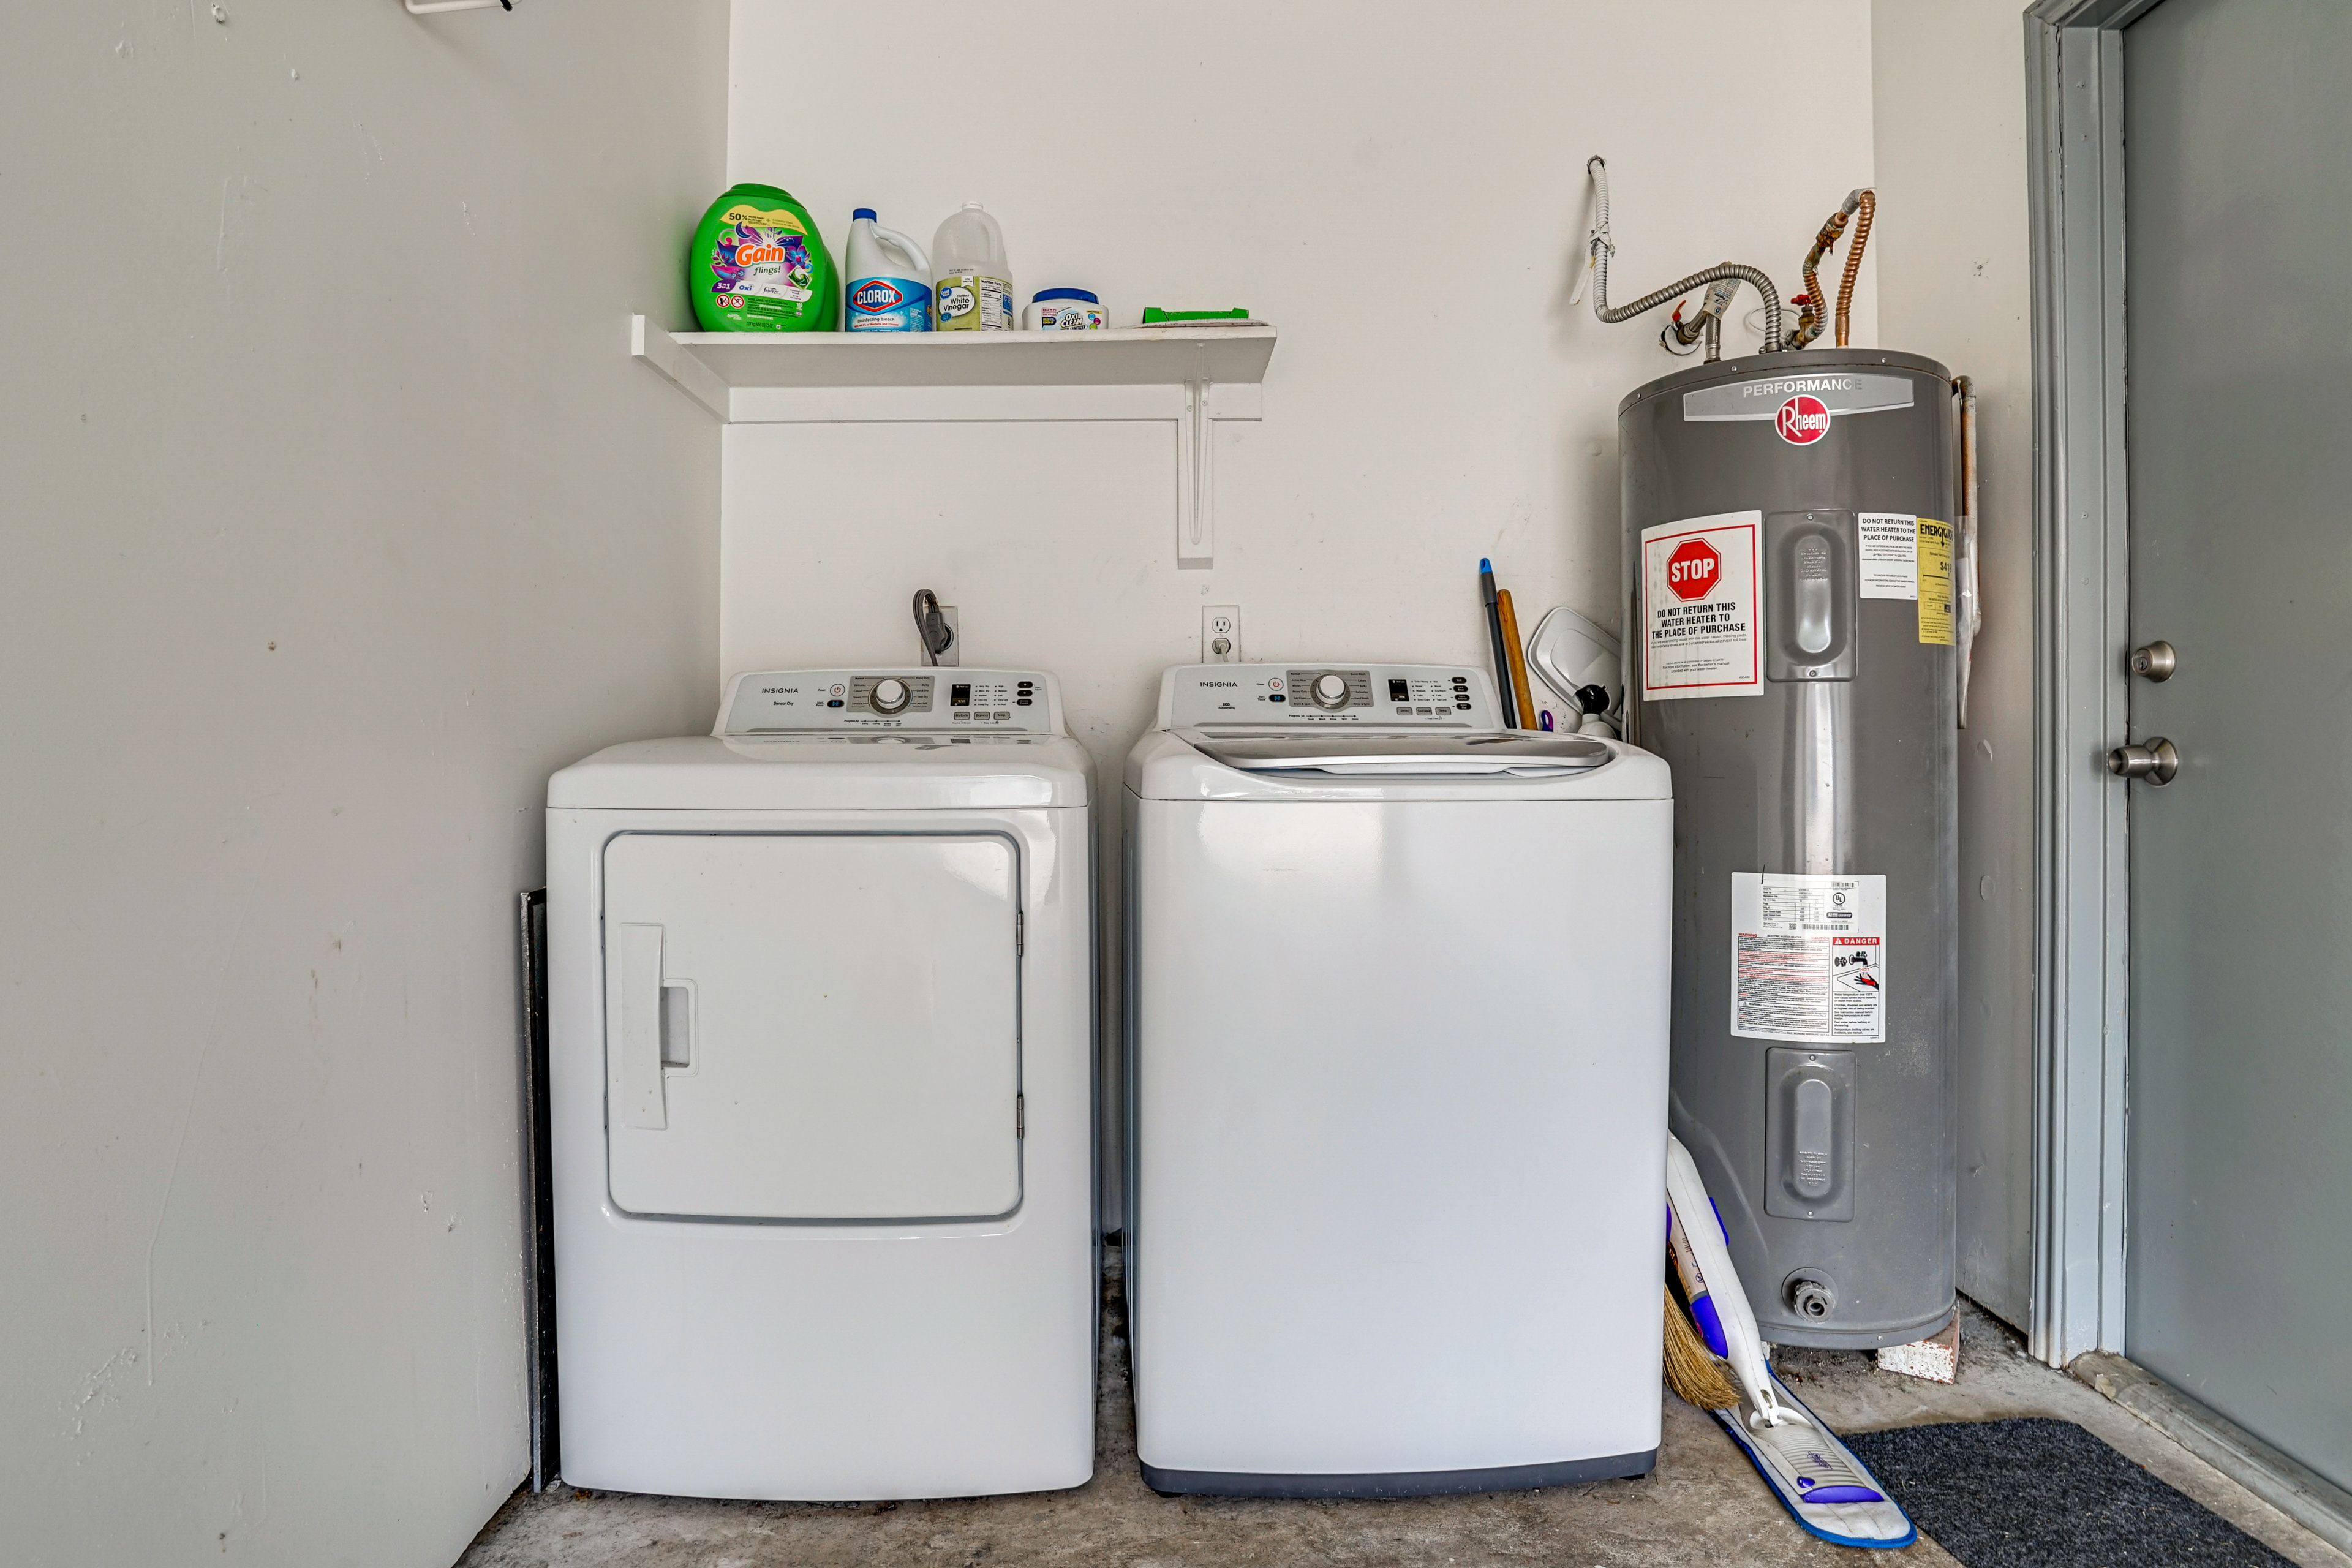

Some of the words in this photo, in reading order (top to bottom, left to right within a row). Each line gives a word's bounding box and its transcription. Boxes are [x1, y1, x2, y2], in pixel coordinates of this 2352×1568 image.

[736, 244, 784, 266] Gain
[753, 265, 781, 276] flings!
[858, 289, 896, 304] CLOROX
[1061, 318, 1082, 328] CLEAN
[1743, 379, 1862, 398] PERFORMANCE
[1781, 398, 1826, 437] Rheem
[1671, 557, 1714, 582] STOP
[1657, 609, 1665, 618] DO
[1667, 607, 1681, 616] NOT
[1683, 603, 1713, 615] RETURN
[1716, 602, 1736, 611] THIS
[1661, 617, 1684, 628] WATER
[1686, 614, 1716, 625] HEATER
[1720, 613, 1730, 622] TO
[1652, 631, 1662, 639] THE
[1664, 627, 1686, 638] PLACE
[1689, 626, 1698, 635] OF
[1700, 623, 1746, 635] PURCHASE
